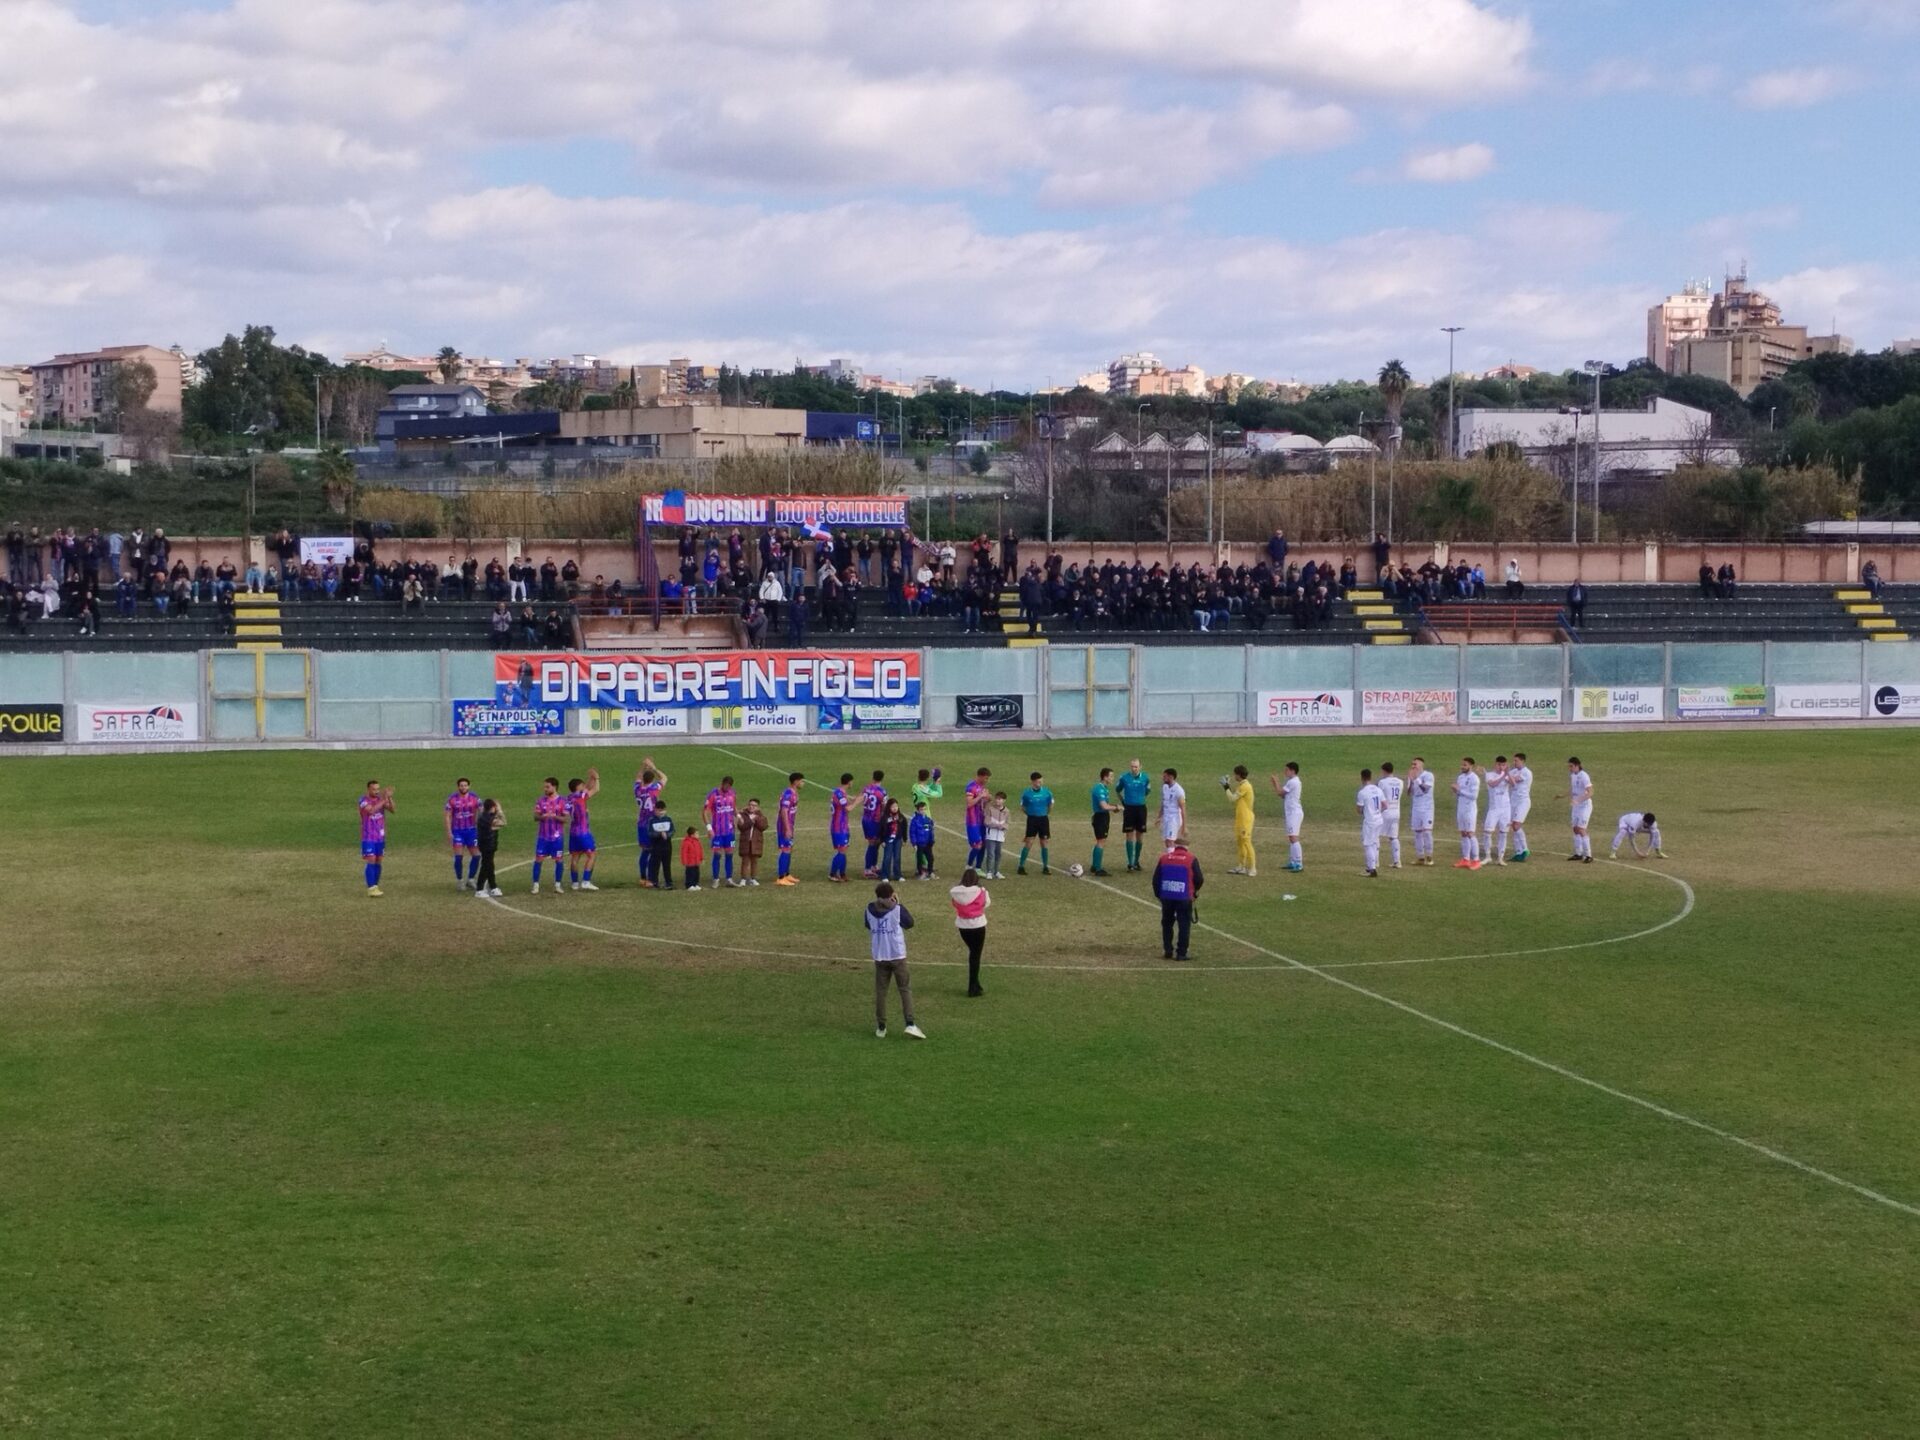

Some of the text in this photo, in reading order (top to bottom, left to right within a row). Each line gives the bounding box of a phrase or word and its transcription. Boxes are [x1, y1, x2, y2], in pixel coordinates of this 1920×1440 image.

[646, 499, 766, 522] IRDUCIBILI
[775, 500, 905, 524] RIONE SALINELLE
[541, 658, 907, 702] DI PADRE IN FIGLIO
[1612, 690, 1640, 704] Luigi
[1471, 699, 1558, 709] BIOCHEMICAL AGRO
[1612, 704, 1655, 715] Floridia
[479, 711, 536, 721] ETNAPOLIS
[628, 715, 677, 727] Floridia
[748, 714, 796, 725] Floridia
